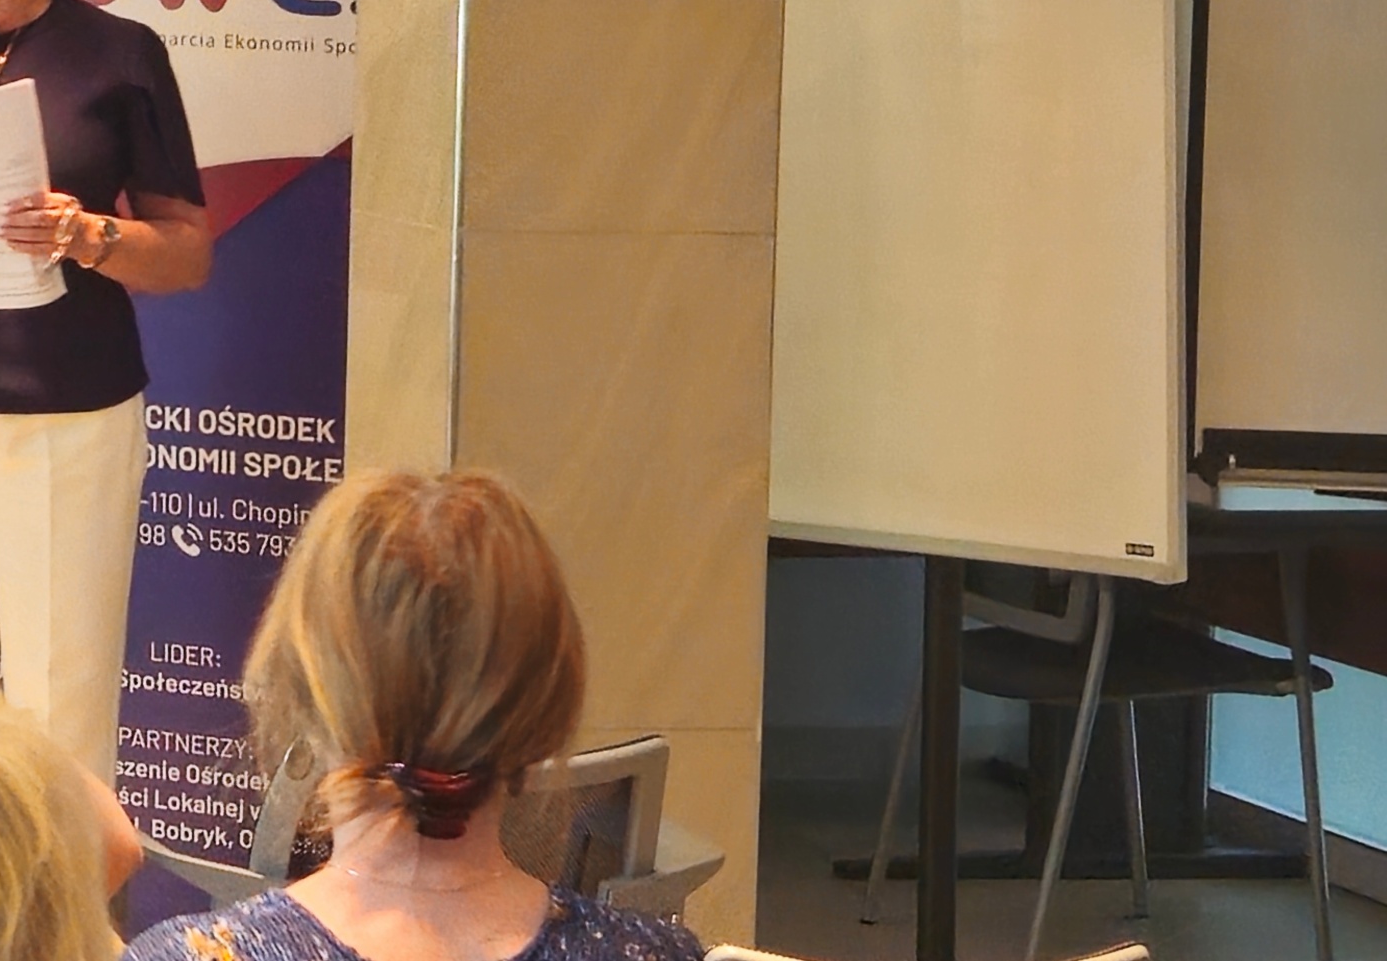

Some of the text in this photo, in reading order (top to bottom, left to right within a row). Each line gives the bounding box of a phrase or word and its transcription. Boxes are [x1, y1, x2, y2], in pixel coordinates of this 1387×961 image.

[224, 33, 315, 52] Ekonomii
[145, 405, 336, 444] CKI OŚRODEK
[199, 497, 225, 519] ul.
[209, 529, 251, 554] 535
[150, 641, 222, 668] LIDER:
[118, 727, 254, 760] PARTNERZY:
[154, 789, 244, 823] Lokalnej
